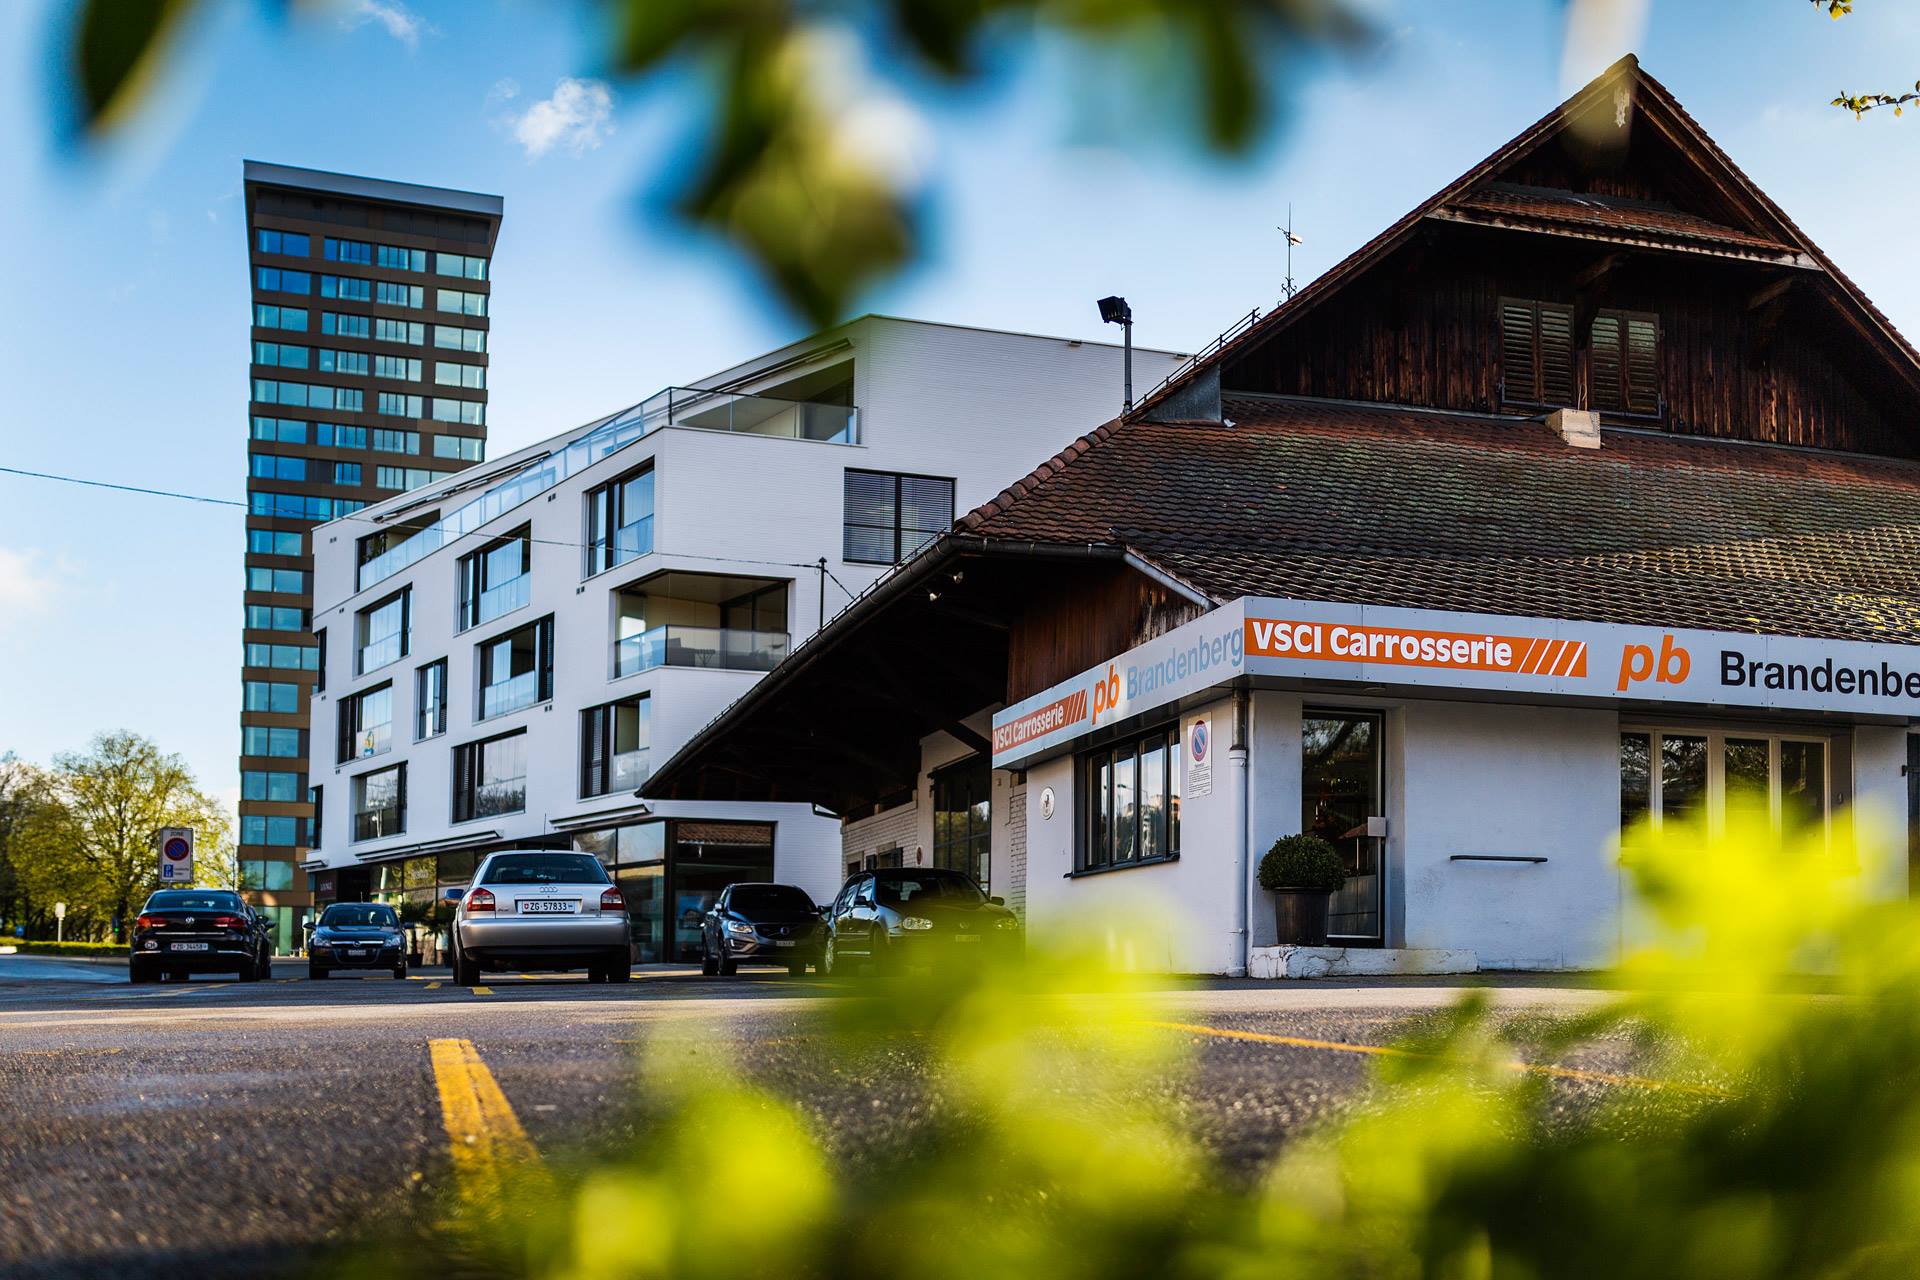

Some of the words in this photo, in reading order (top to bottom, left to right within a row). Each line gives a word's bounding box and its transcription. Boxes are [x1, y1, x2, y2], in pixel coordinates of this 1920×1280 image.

[1126, 626, 1244, 701] Brandenberg
[1253, 621, 1322, 654] VSCI
[1330, 627, 1513, 667] Carrosserie
[1616, 634, 1691, 692] pb
[1091, 664, 1120, 725] pb
[1720, 650, 1920, 698] Brandenbe
[994, 724, 1013, 750] VSCI
[1013, 704, 1064, 742] Carrosserie
